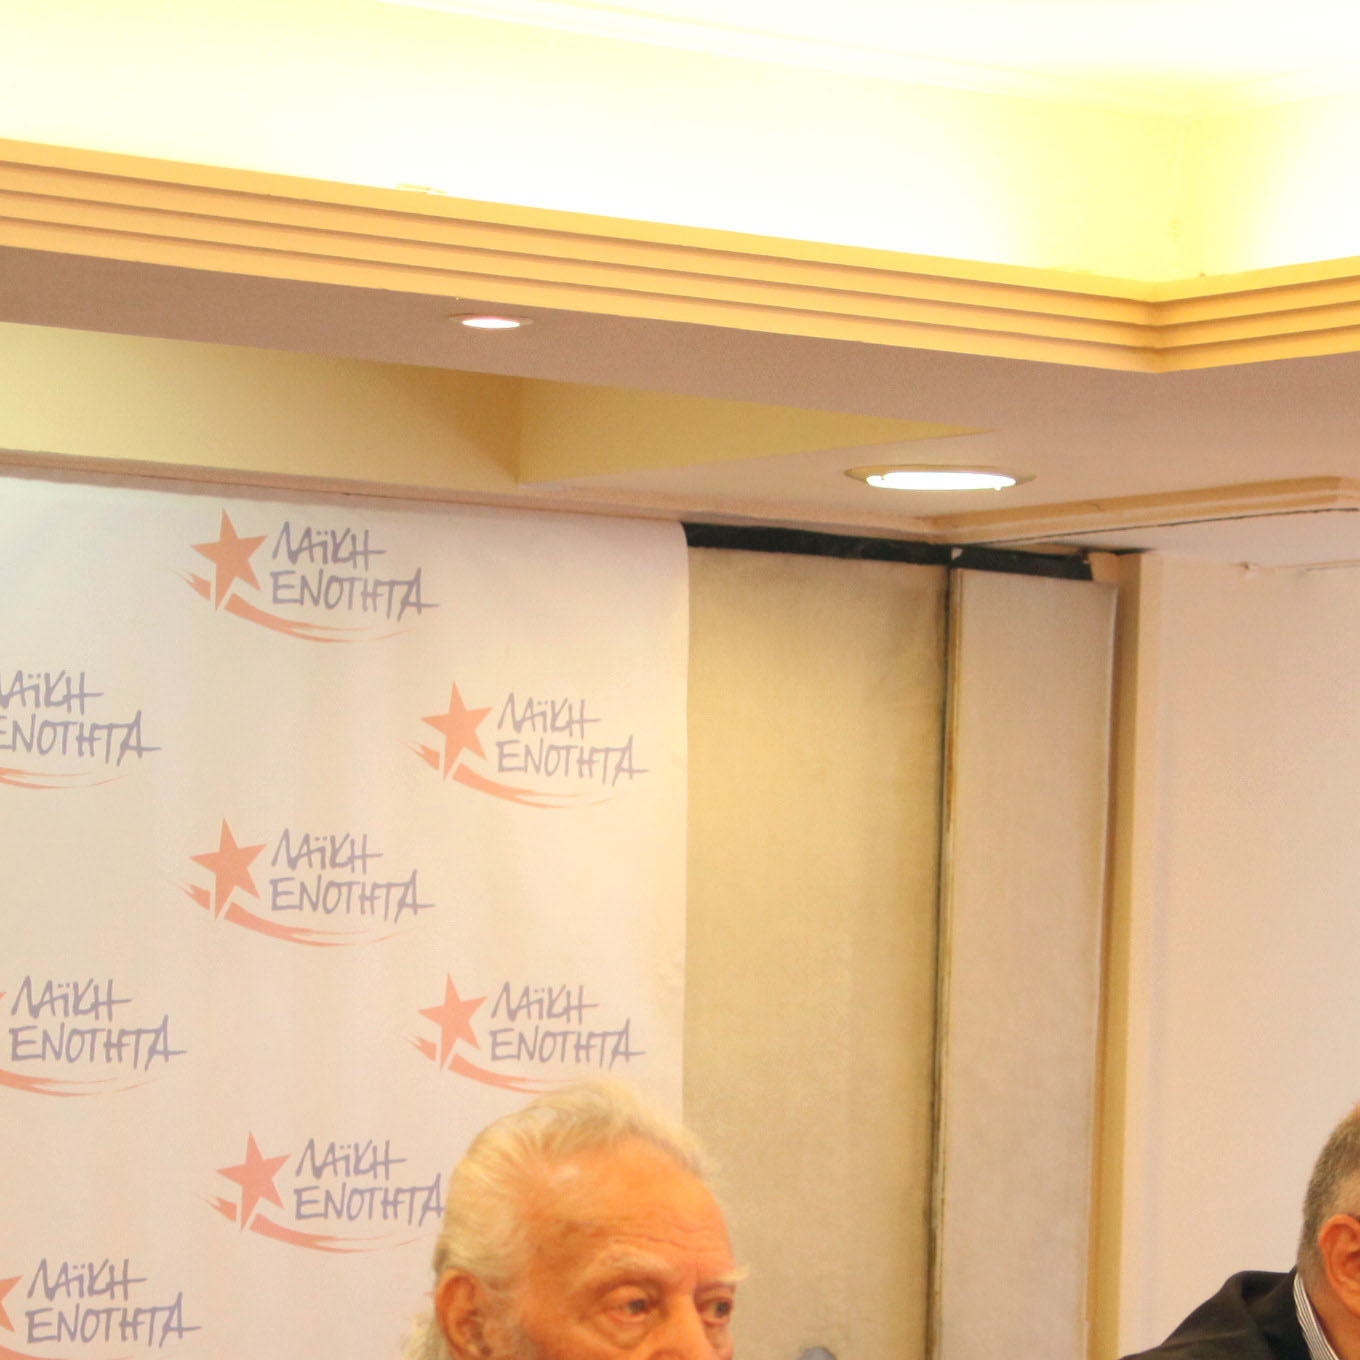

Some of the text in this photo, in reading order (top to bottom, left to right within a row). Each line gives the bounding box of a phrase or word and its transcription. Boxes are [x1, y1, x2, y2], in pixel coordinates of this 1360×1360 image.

[269, 567, 441, 623] ΕΝΟΤΗΤΑ
[494, 736, 651, 787] ΕΝΟΤΗΤΑ
[268, 869, 437, 924] ΕΝΟΤΗΤΑ
[8, 1015, 188, 1072] ΕΝΟΤΗΤΑ
[488, 1019, 647, 1069] ΕΝΟΤΗΤΑ
[292, 1172, 444, 1228] ΕΝΟΤΗΤΑ
[24, 1292, 203, 1349] ΕΝΟΤΗΤΑ
